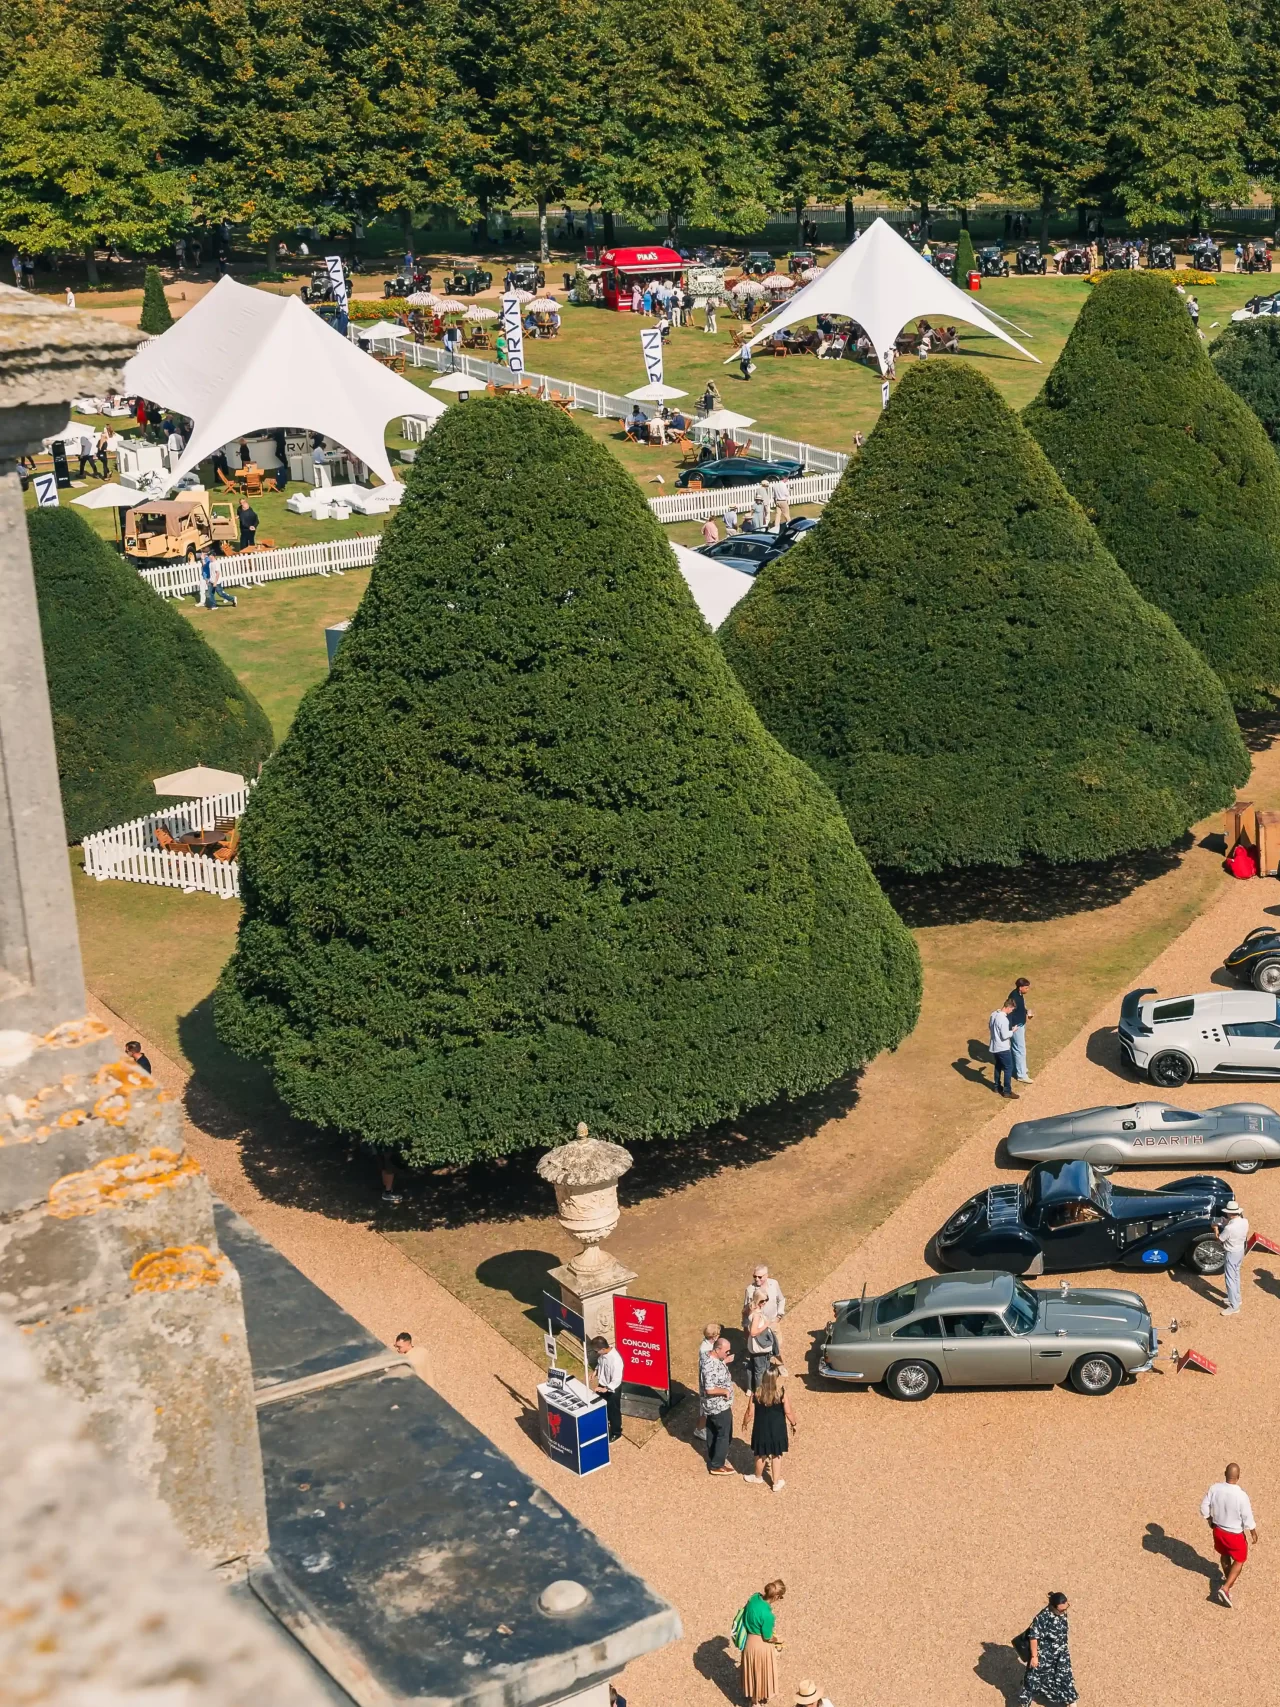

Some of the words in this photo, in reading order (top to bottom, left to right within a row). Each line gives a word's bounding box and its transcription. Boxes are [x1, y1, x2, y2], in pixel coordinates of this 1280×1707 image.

[504, 299, 523, 372] DRVN
[1132, 1134, 1204, 1147] ABARTH
[622, 1338, 660, 1351] CONCOURS
[632, 1348, 651, 1358] CARS
[631, 1356, 639, 1364] 20
